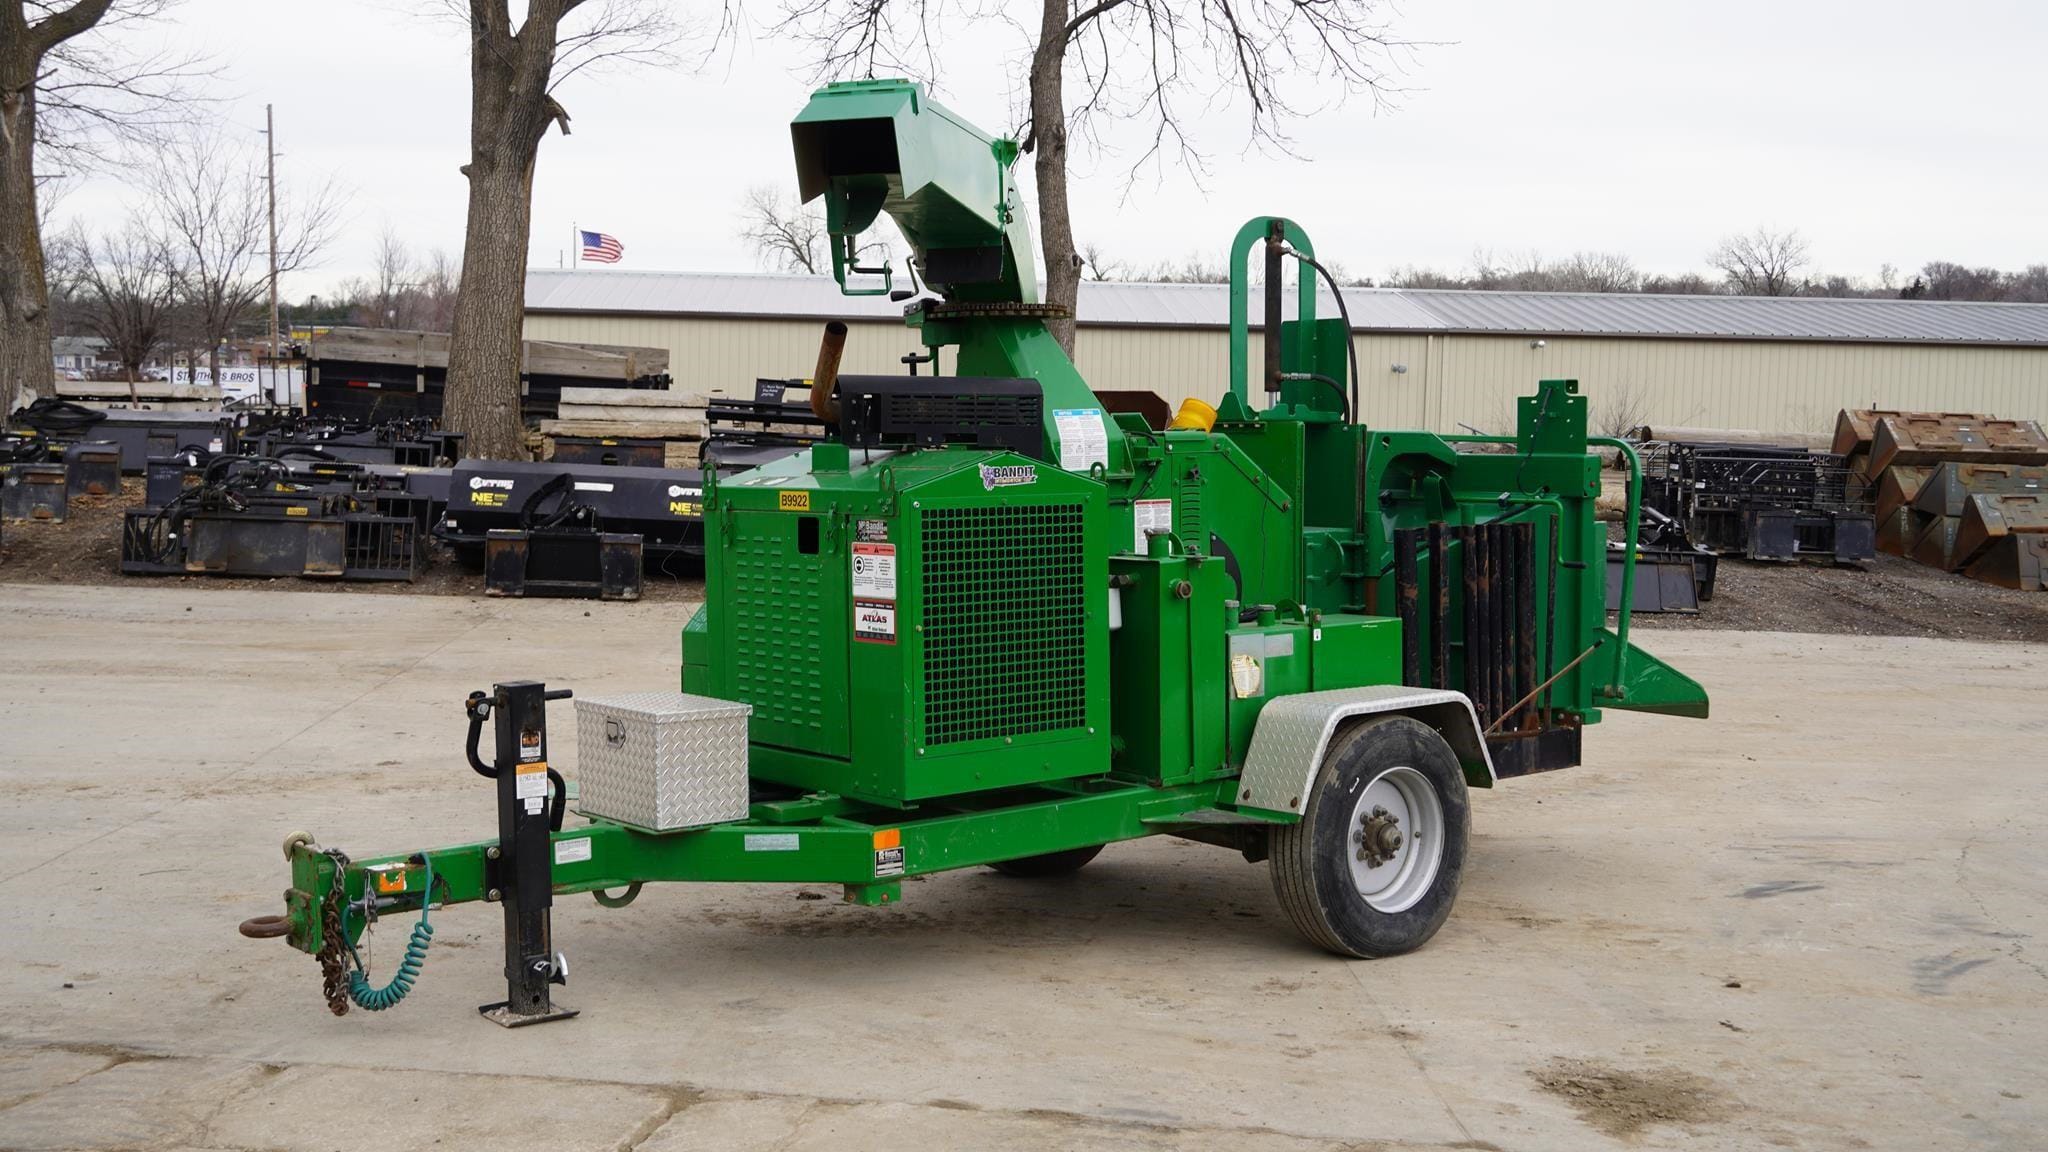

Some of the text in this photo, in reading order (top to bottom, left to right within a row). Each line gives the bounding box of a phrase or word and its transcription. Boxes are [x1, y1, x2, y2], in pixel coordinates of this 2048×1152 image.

[230, 372, 255, 382] BROS
[993, 467, 1033, 477] BANDIT
[471, 492, 494, 503] NE
[781, 494, 807, 507] B9922
[670, 501, 692, 512] NE
[862, 613, 887, 624] ATLAS
